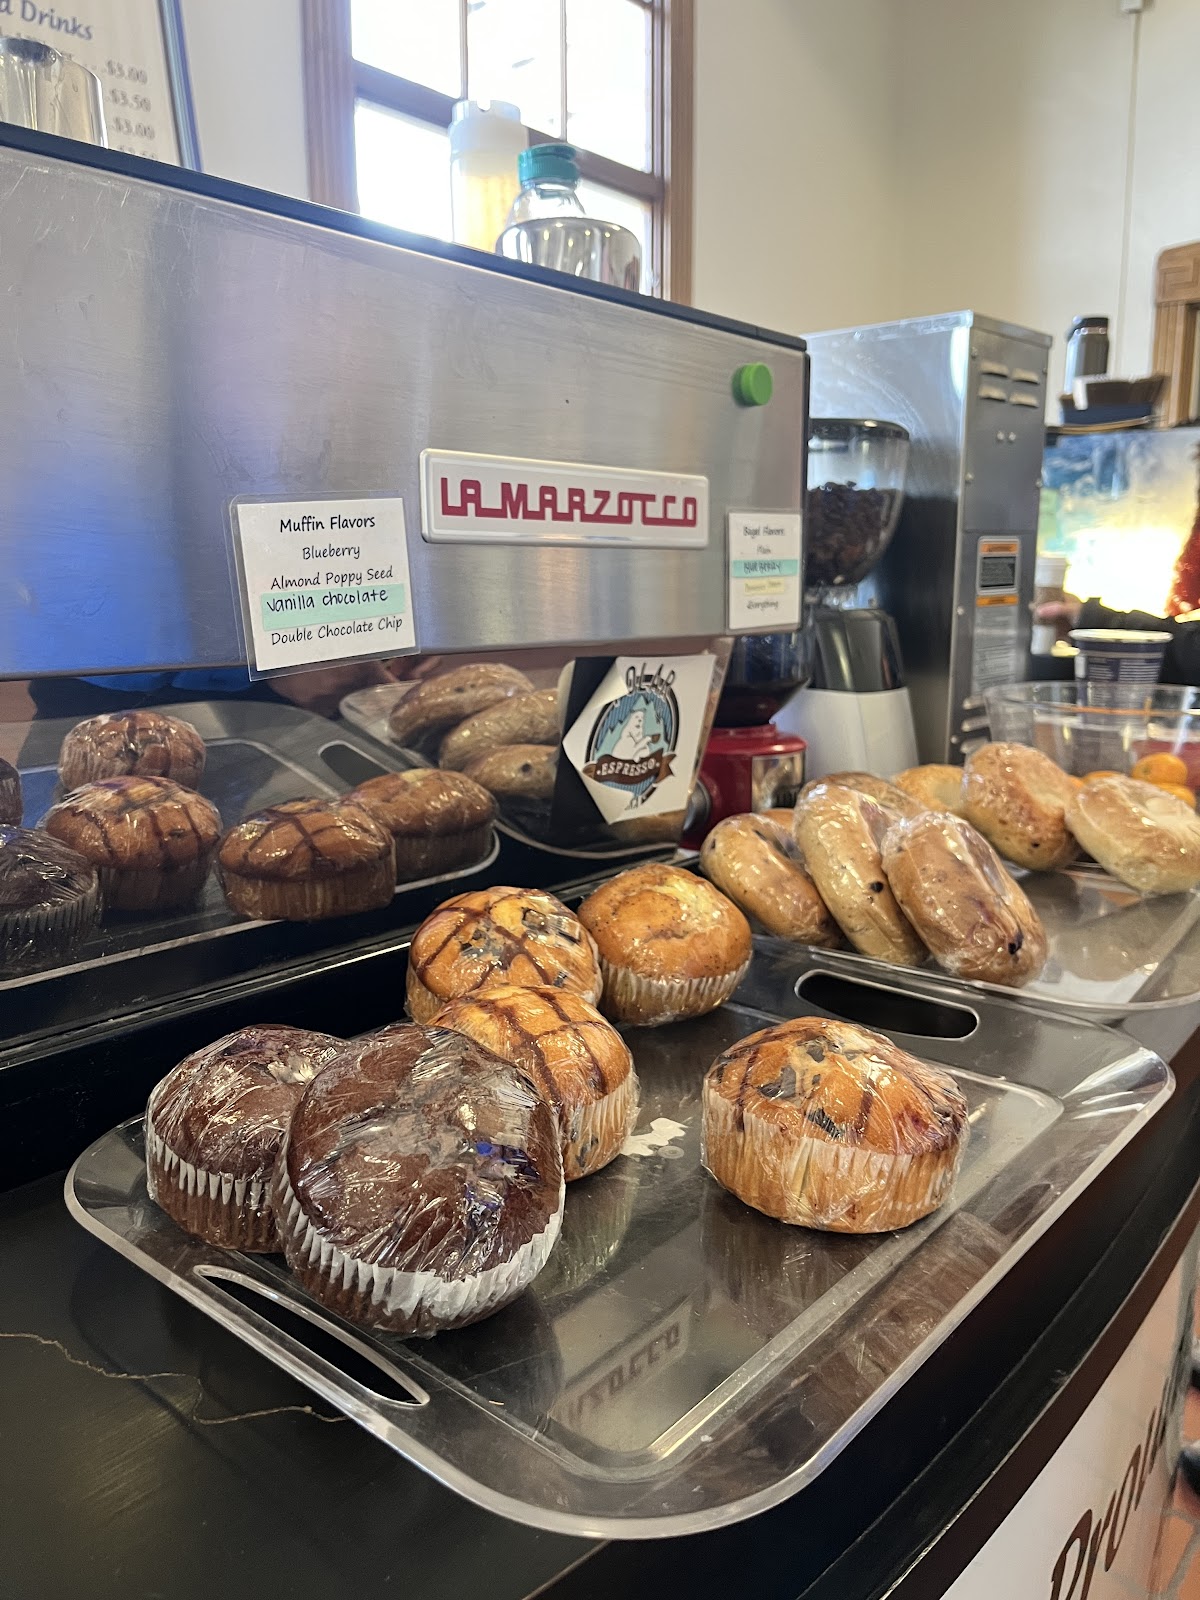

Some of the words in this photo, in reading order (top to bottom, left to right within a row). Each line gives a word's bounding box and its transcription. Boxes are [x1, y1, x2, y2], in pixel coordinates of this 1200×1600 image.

[20, 0, 93, 41] Drinks
[441, 477, 490, 518] LA
[501, 482, 697, 528] MARZOCCO
[280, 515, 325, 533] Muffin
[330, 514, 376, 530] Flavors
[743, 526, 760, 539] Bagel
[302, 543, 361, 560] Blueberry
[270, 572, 320, 590] Almond
[325, 570, 363, 587] Poppy
[367, 565, 394, 580] Seed
[322, 588, 389, 607] chocolate
[271, 628, 313, 646] Double
[317, 621, 374, 639] Chocolate
[377, 616, 403, 632] Chip
[601, 757, 657, 777] ESPRESSO
